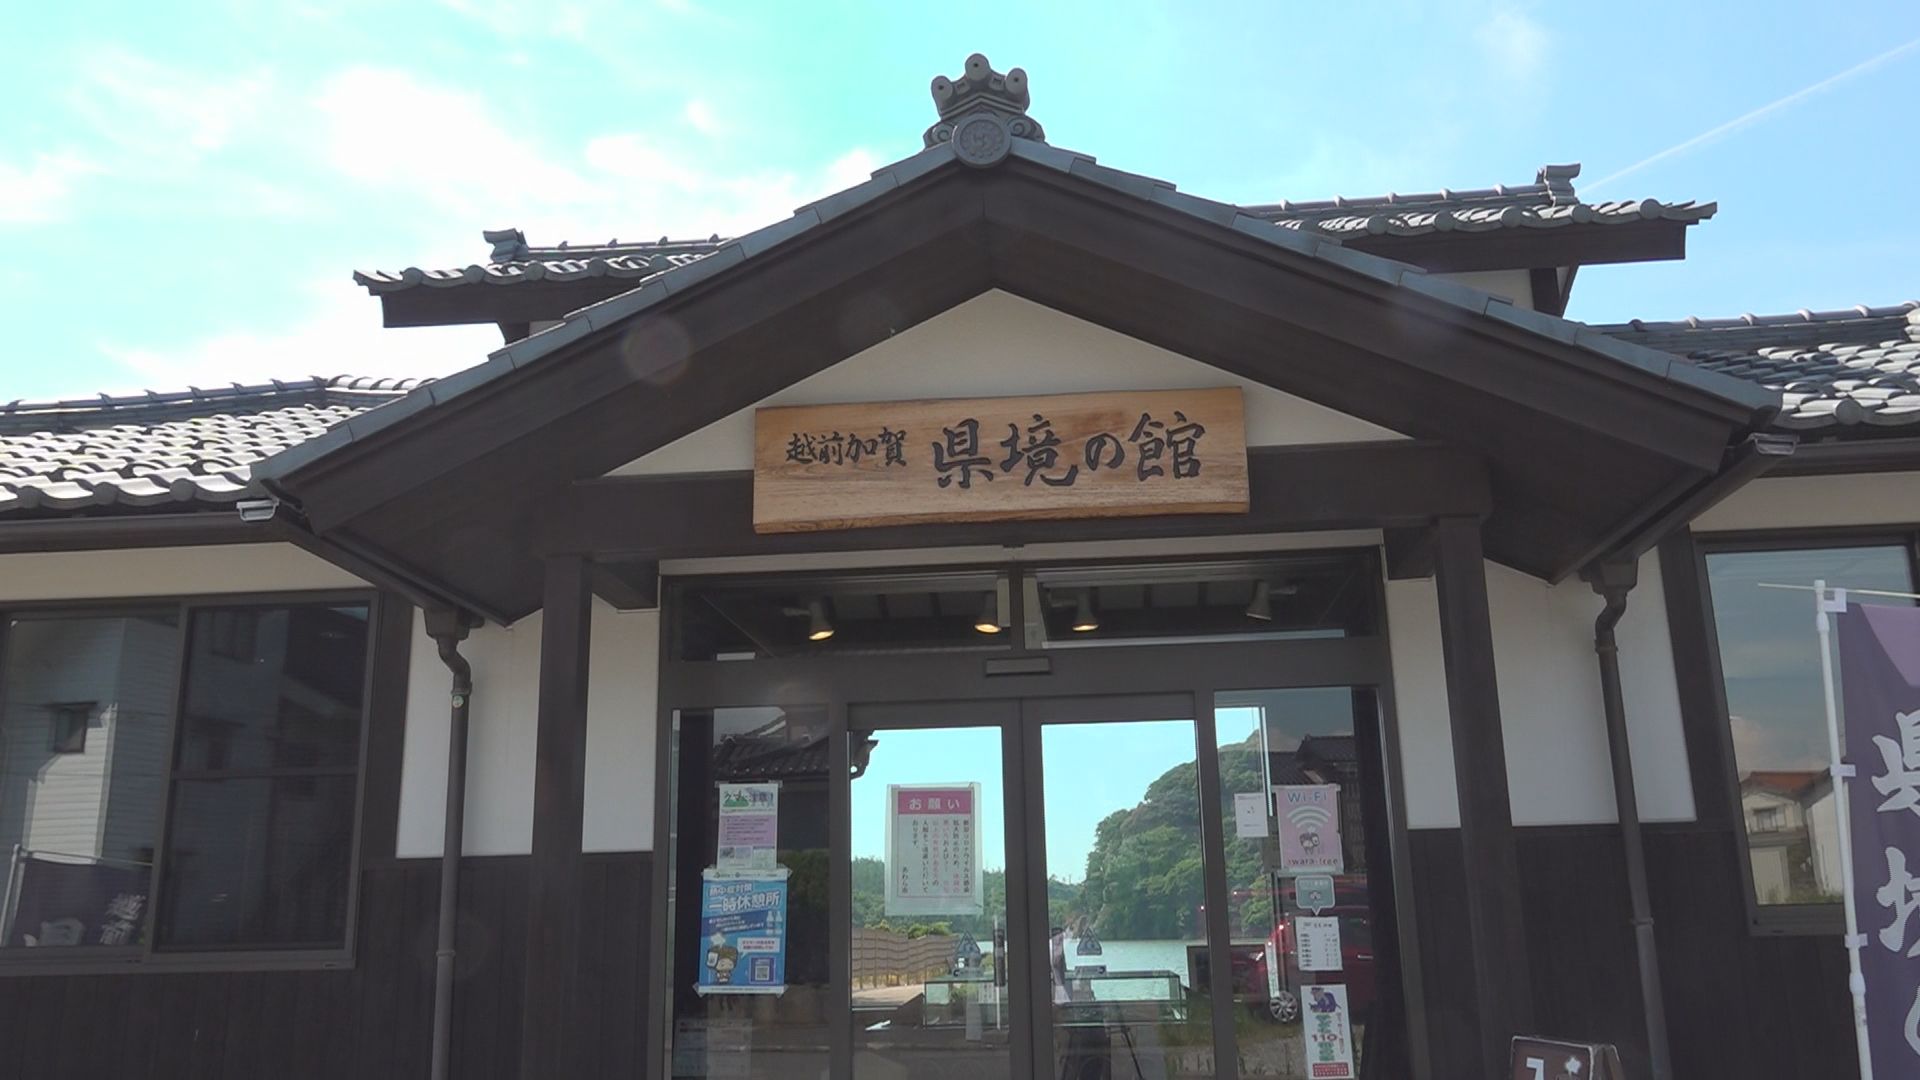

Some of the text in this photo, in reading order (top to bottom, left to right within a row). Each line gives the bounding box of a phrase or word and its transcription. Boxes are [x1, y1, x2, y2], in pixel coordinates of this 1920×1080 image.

[785, 410, 1205, 489] 越前加賀 県境の館
[908, 797, 961, 811] お願い
[708, 890, 780, 913] 一時休憩所
[1311, 1033, 1337, 1042] 110
